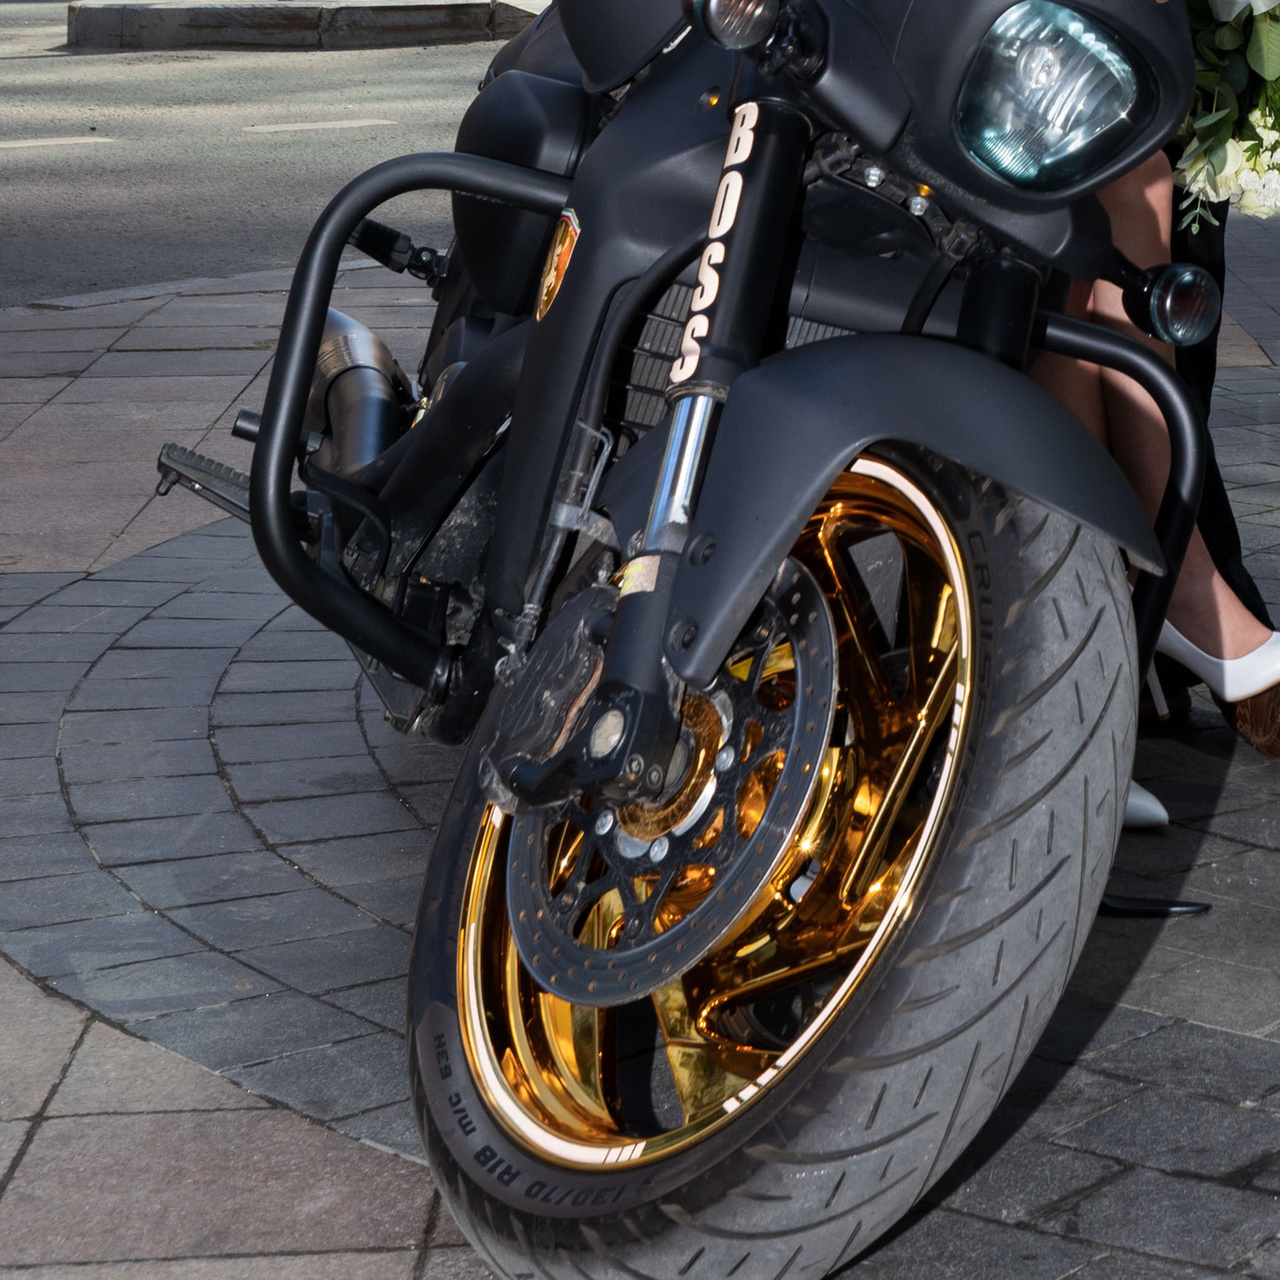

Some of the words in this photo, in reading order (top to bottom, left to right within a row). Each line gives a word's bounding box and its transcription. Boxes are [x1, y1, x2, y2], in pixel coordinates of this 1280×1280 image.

[669, 100, 758, 384] BOSS
[432, 1032, 453, 1081] 63H
[473, 1144, 522, 1187] R18
[524, 1180, 628, 1207] 130/70
